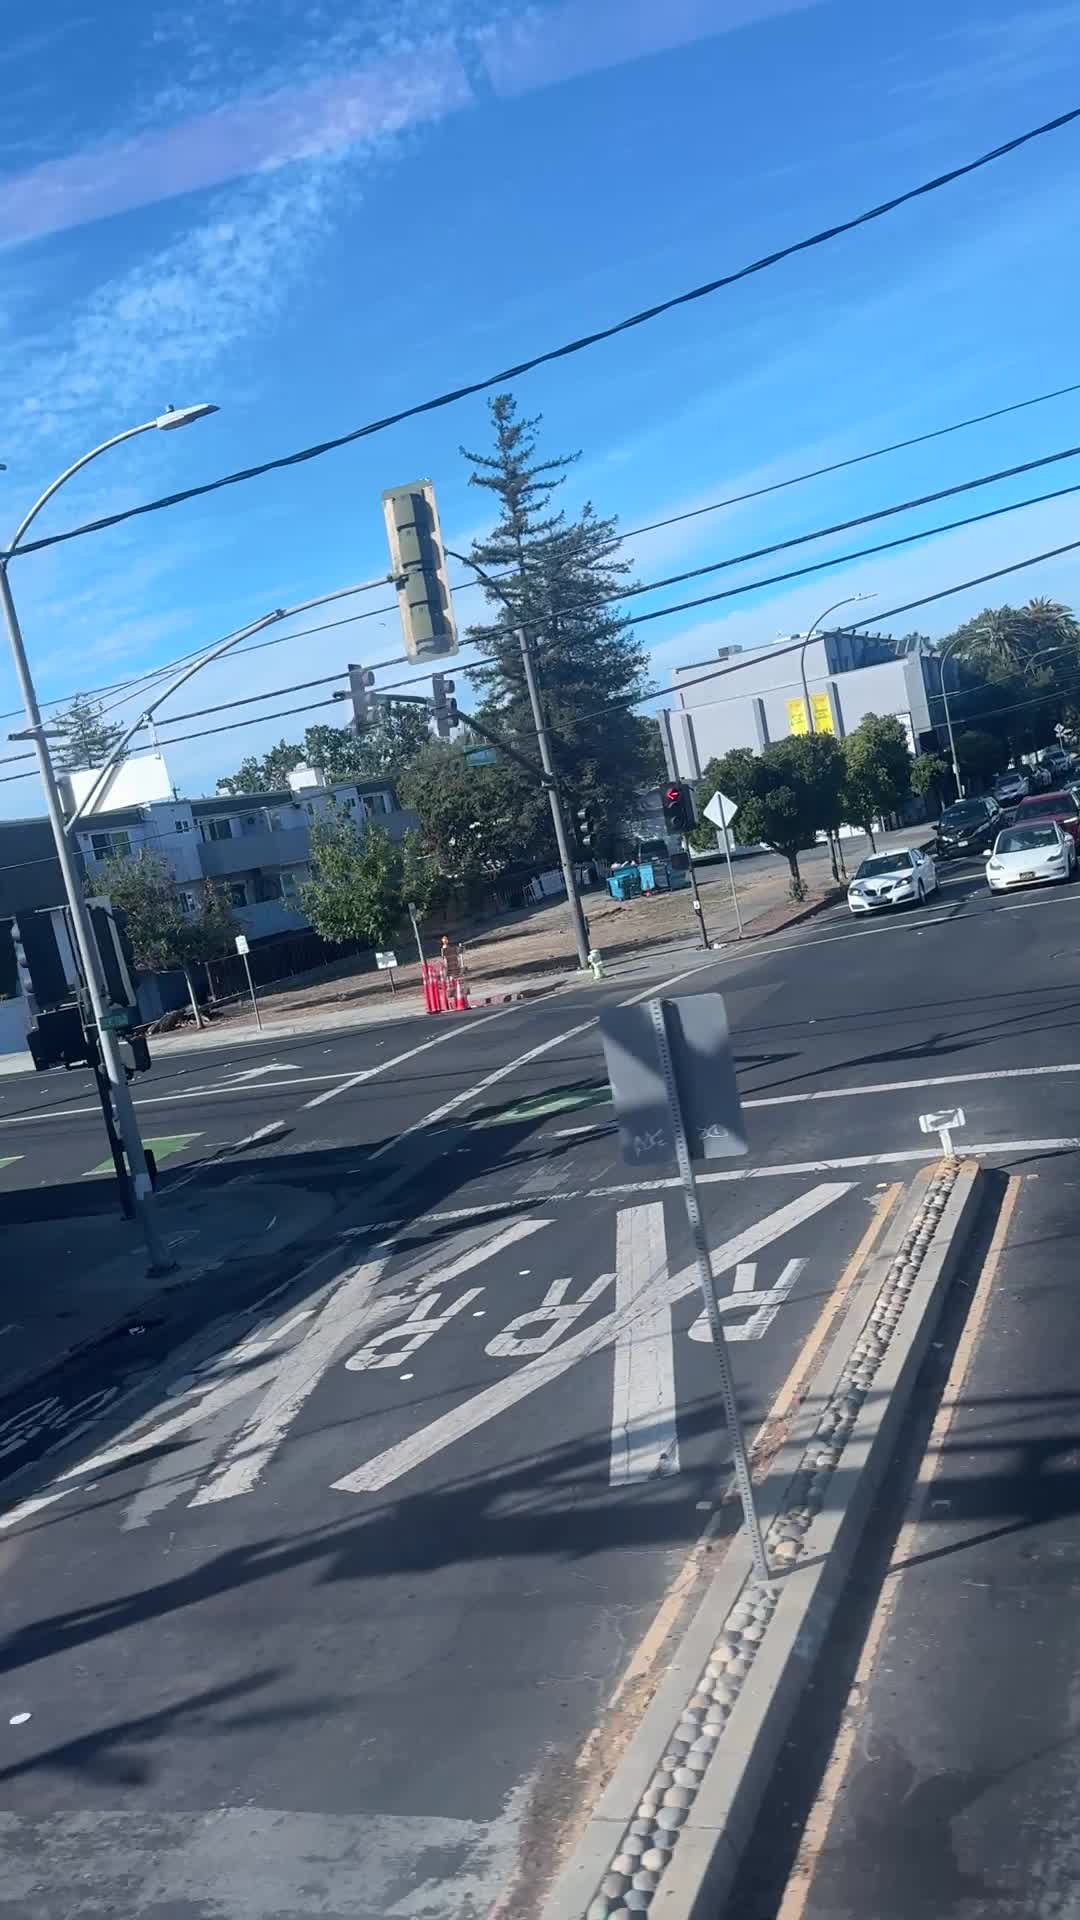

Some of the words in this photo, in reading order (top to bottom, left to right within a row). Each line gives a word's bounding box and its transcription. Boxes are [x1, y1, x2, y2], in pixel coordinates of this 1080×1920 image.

[345, 1288, 485, 1371] R
[484, 1273, 617, 1357] R
[688, 1257, 810, 1342] R
